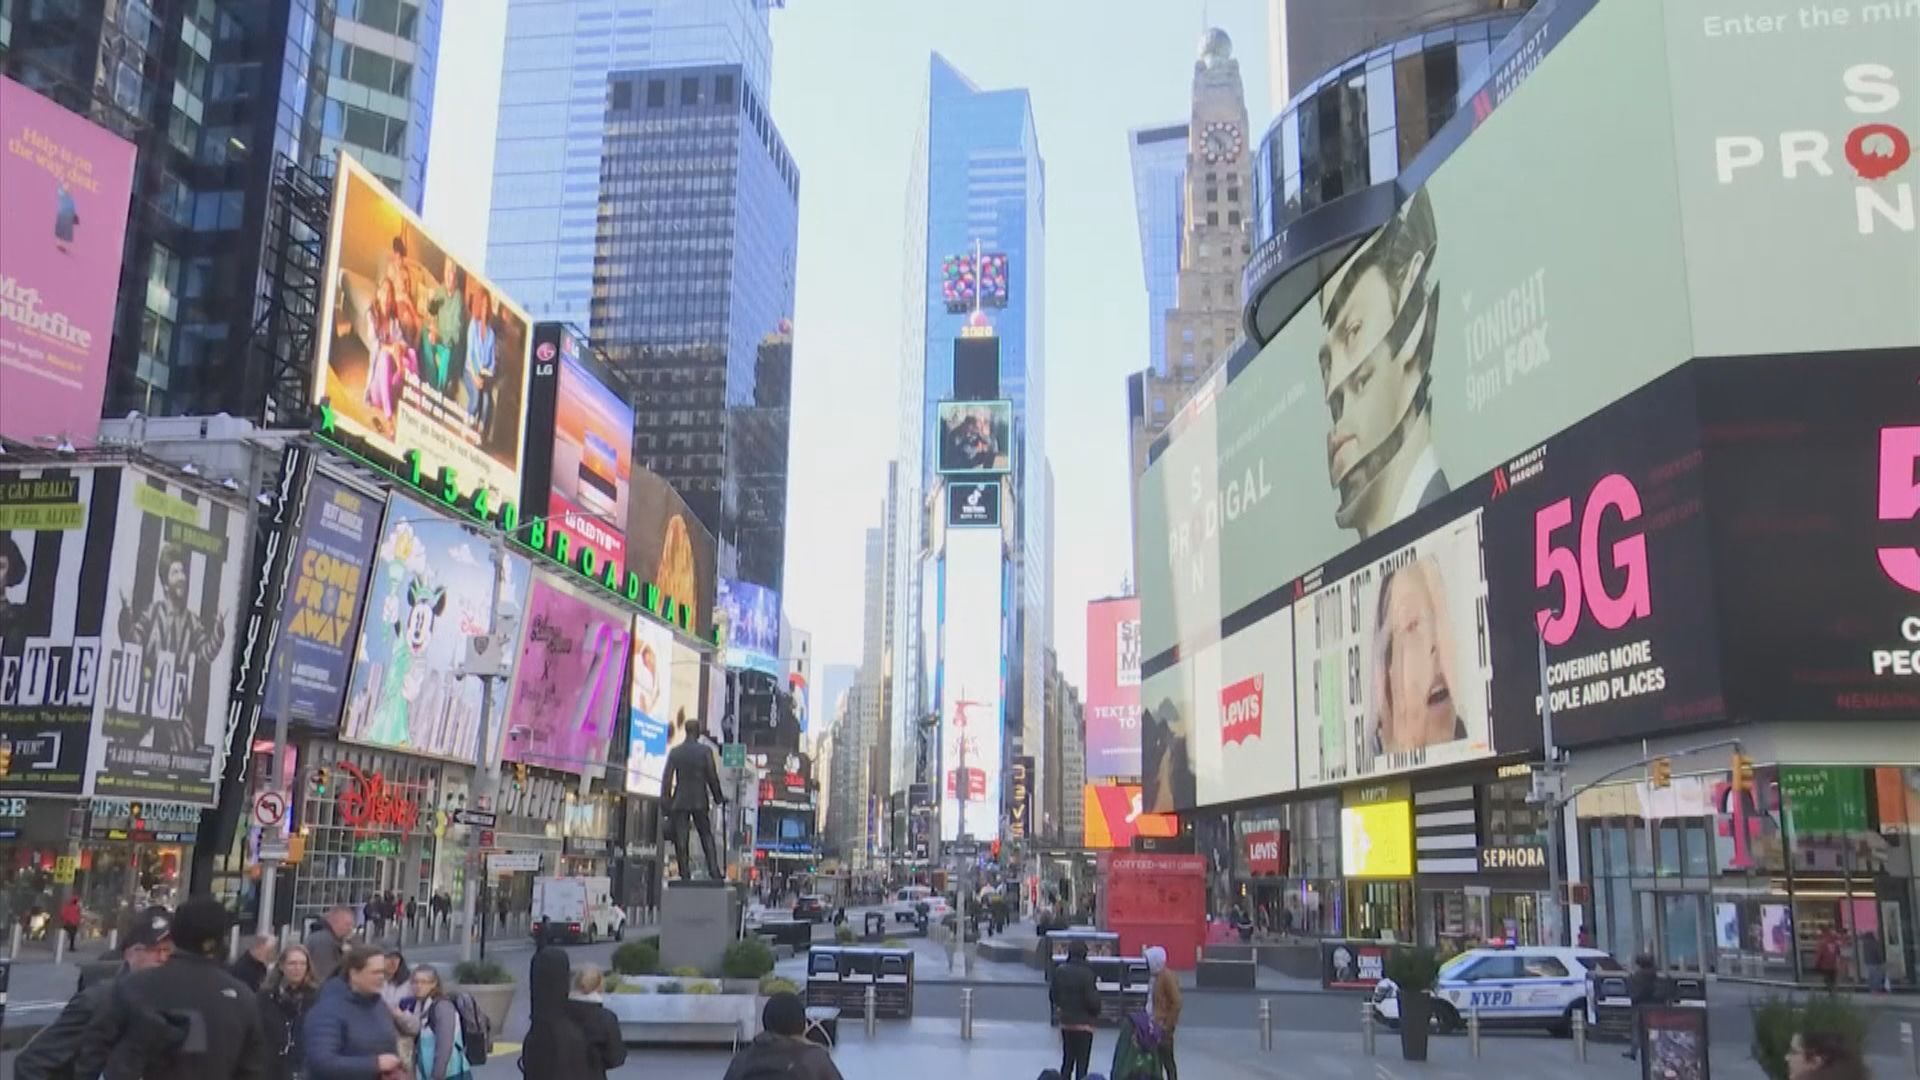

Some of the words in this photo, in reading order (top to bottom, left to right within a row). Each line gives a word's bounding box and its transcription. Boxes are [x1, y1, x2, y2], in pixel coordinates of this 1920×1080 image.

[1703, 14, 1787, 36] Enter
[1798, 5, 1850, 28] the
[1465, 267, 1545, 367] TONIGHT
[536, 364, 553, 375] LG
[1504, 320, 1551, 385] FOX
[410, 448, 519, 532] 1540
[530, 515, 691, 633] BROADWAY
[1535, 473, 1651, 645] 5G
[303, 549, 360, 593] COME
[295, 576, 357, 621] FRM
[288, 607, 351, 648] AWAY
[1546, 652, 1609, 686] COVERING
[1610, 640, 1652, 670] MORE
[1094, 706, 1124, 718] TEXT
[1535, 686, 1580, 716] POPLE
[1583, 680, 1610, 705] AND
[1612, 666, 1666, 699] PLACES
[1119, 718, 1136, 728] TO
[141, 801, 202, 823] LUGGAGE
[337, 761, 419, 843] Disney
[1483, 847, 1545, 868] SEPHORA
[1470, 991, 1513, 1006] NYPD
